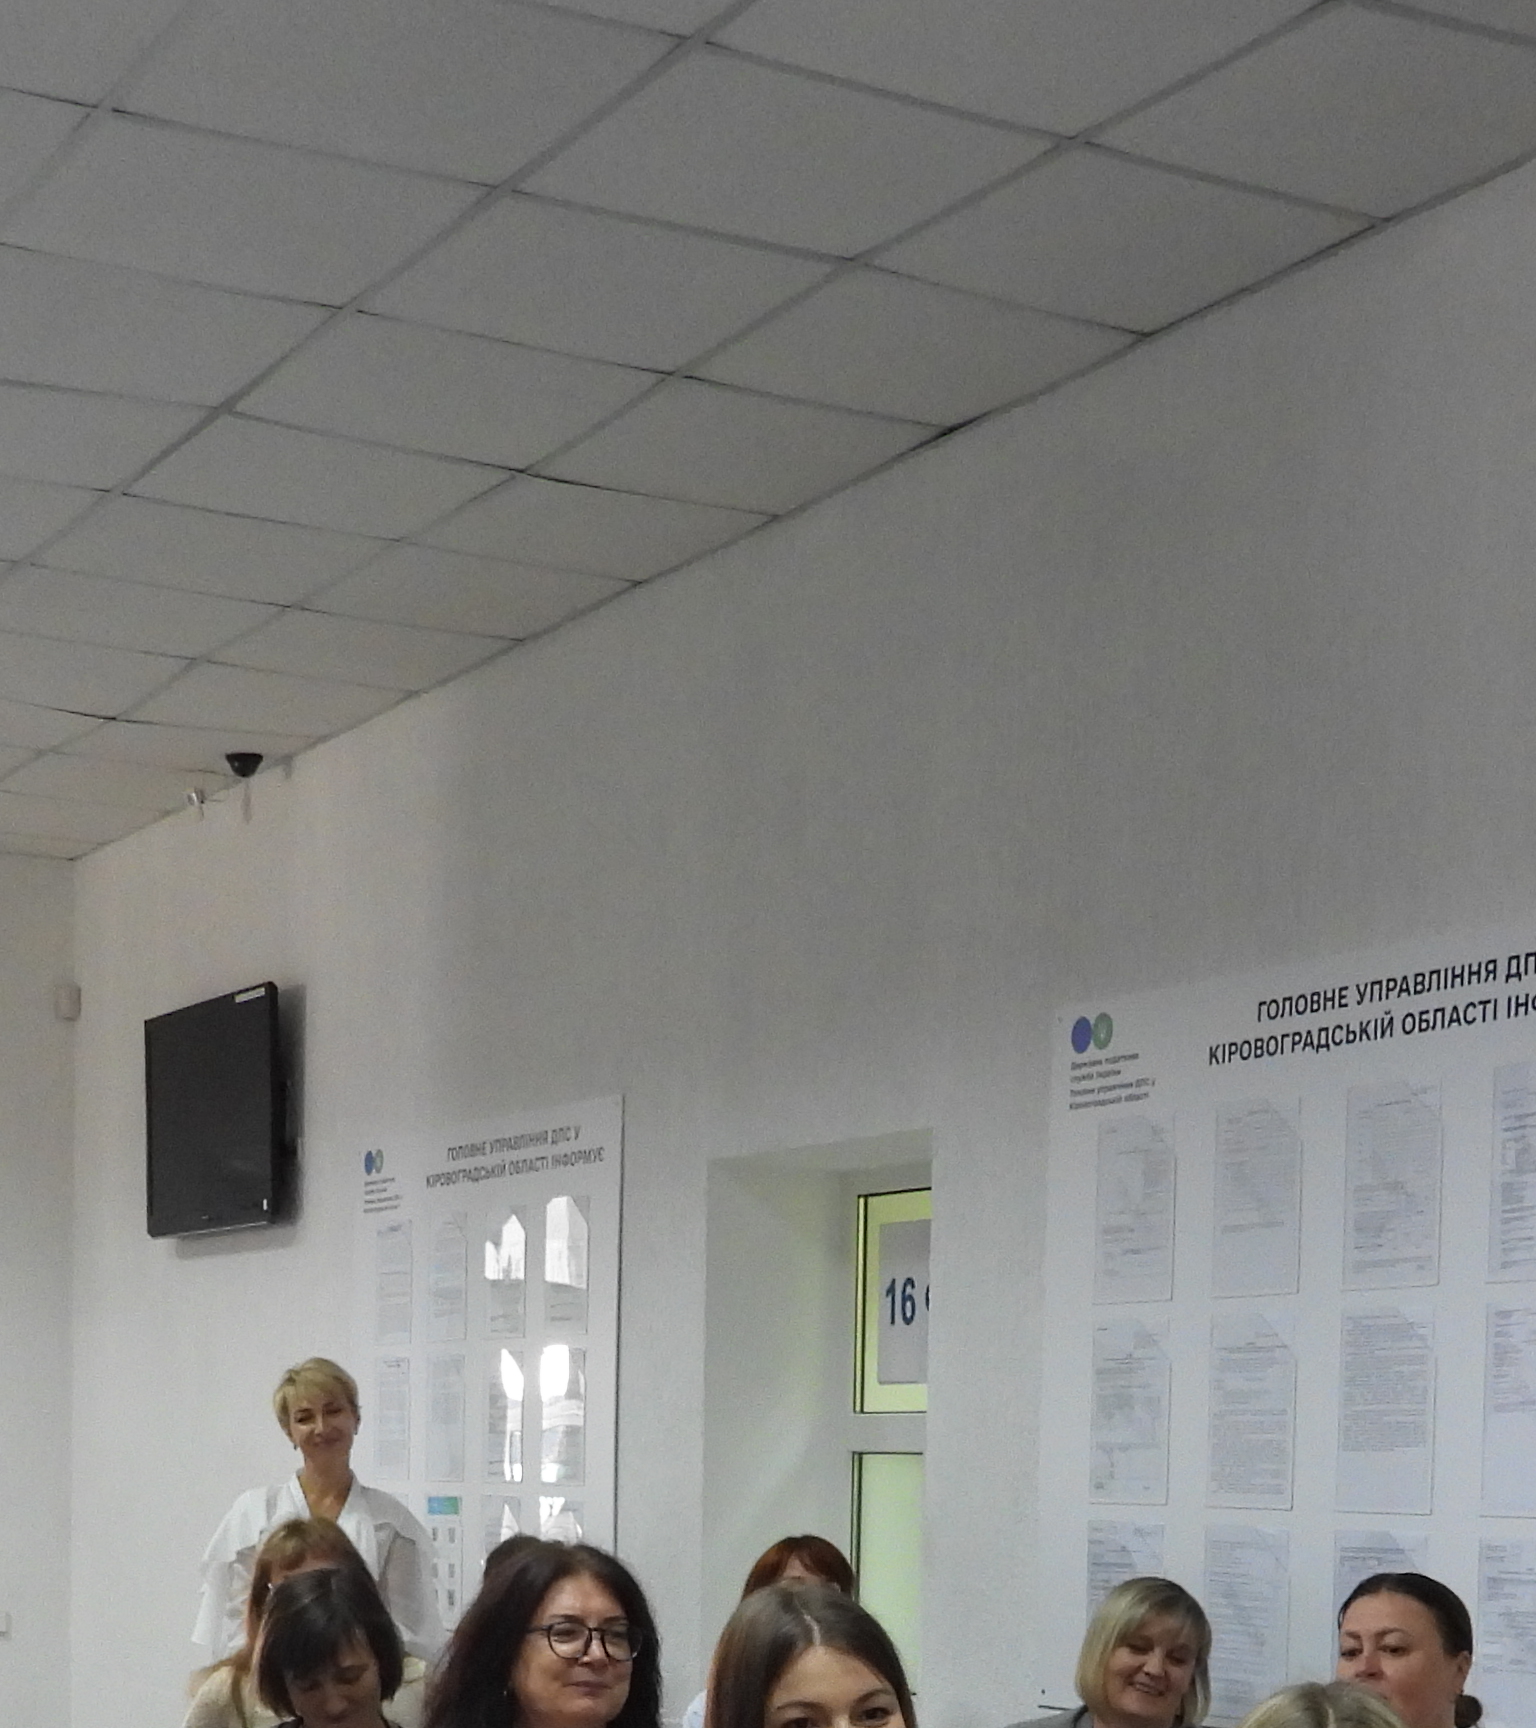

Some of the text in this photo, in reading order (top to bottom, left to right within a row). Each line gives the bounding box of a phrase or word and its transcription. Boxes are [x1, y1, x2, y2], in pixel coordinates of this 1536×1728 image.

[1257, 985, 1349, 1023] ГОЛОВНЕ
[1355, 958, 1497, 1006] УПРАВЛІННЯ
[1208, 1010, 1394, 1066] КІРОВОГРАДСЬКІЙ
[1402, 997, 1498, 1036] ОБЛАСТІ
[885, 1277, 916, 1326] 16
